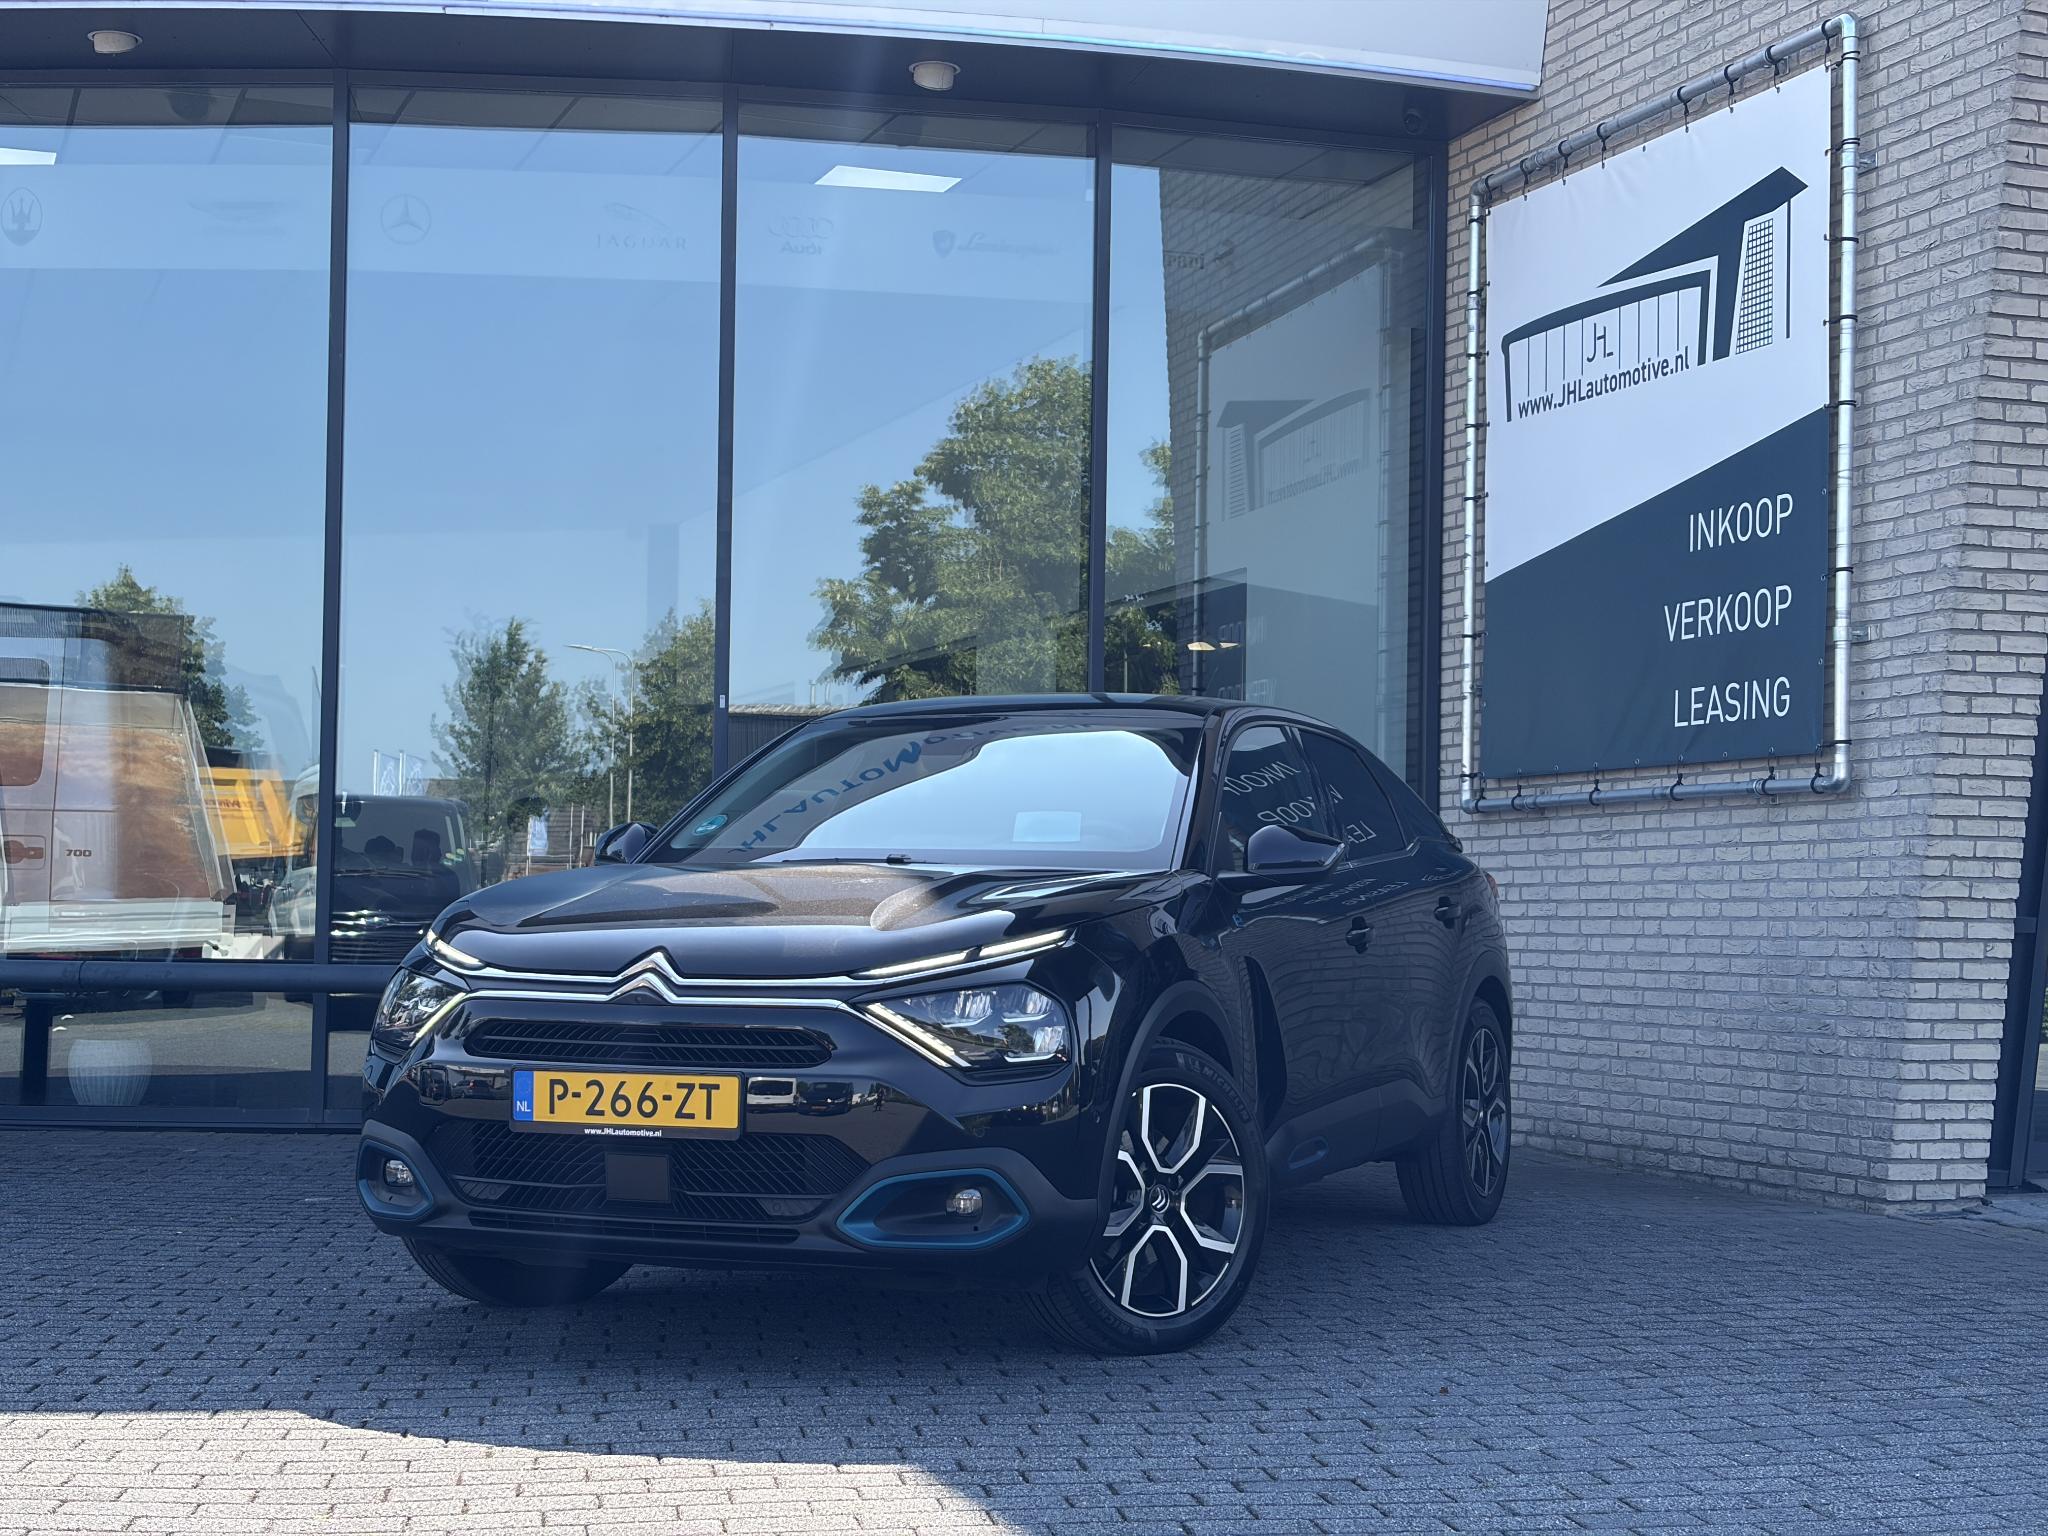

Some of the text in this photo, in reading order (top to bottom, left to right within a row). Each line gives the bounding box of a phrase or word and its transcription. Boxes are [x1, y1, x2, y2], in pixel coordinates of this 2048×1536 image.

[779, 241, 822, 256] Audi
[1517, 345, 1690, 419] www.JHLautomotive.nl
[1689, 492, 1794, 553] INKOOP
[1663, 584, 1793, 642] VERKOOP
[1673, 676, 1791, 728] LEASING
[516, 1100, 531, 1112] NL
[549, 1078, 721, 1121] P-266-ZT
[584, 1127, 662, 1138] www.JHLautomotive.nl
